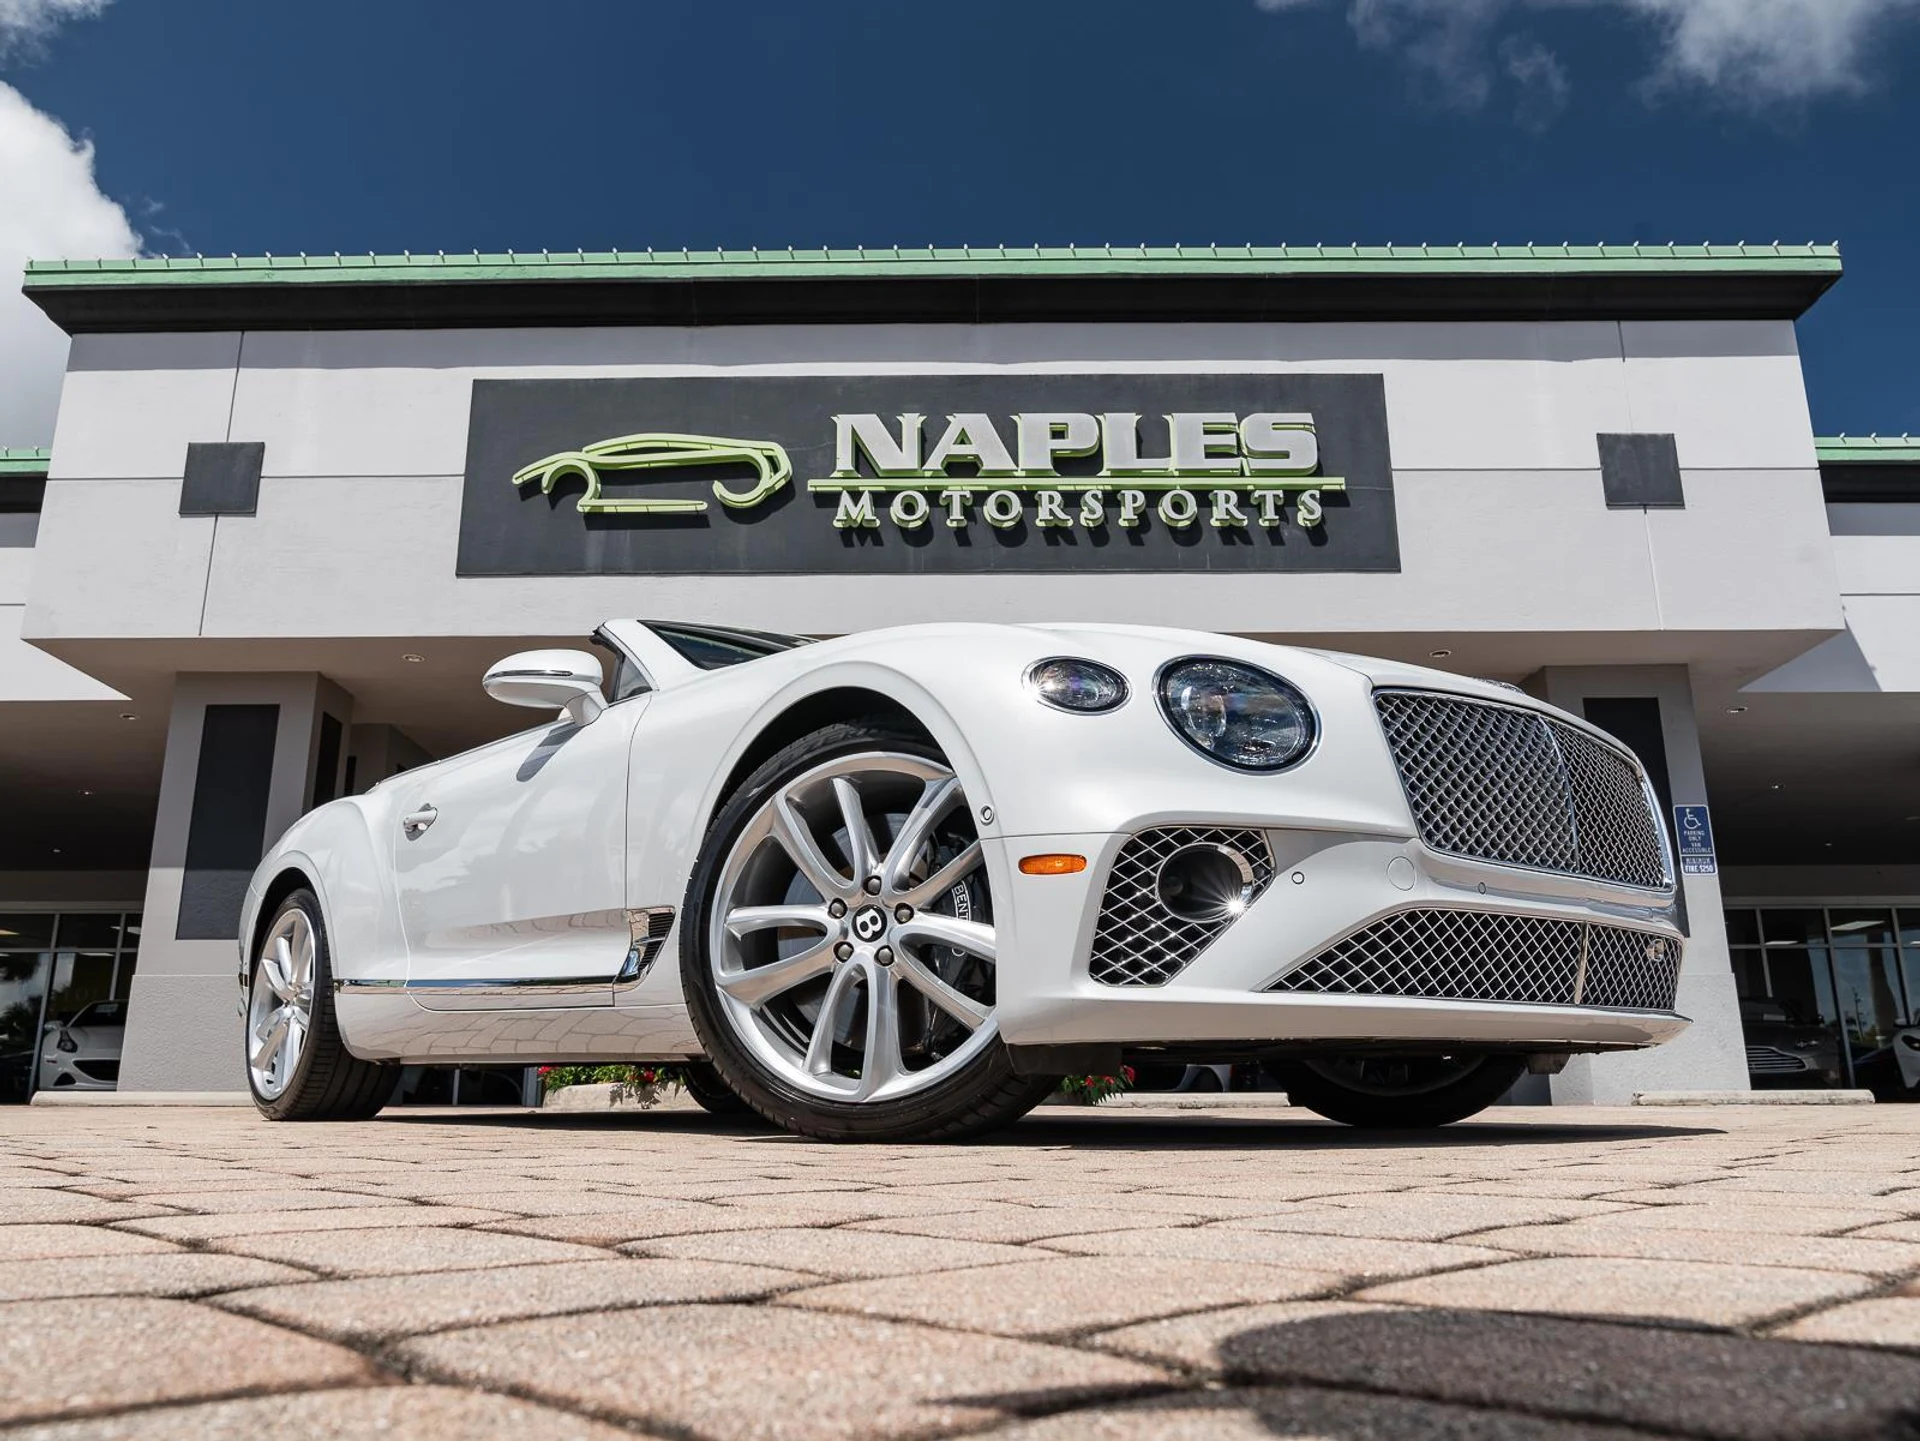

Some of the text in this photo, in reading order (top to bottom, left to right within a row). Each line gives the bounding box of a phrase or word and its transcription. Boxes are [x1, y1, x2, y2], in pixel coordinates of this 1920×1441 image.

[830, 412, 1318, 477] NAPLES
[835, 489, 1323, 528] MOTORSPORTS
[856, 909, 882, 939] B
